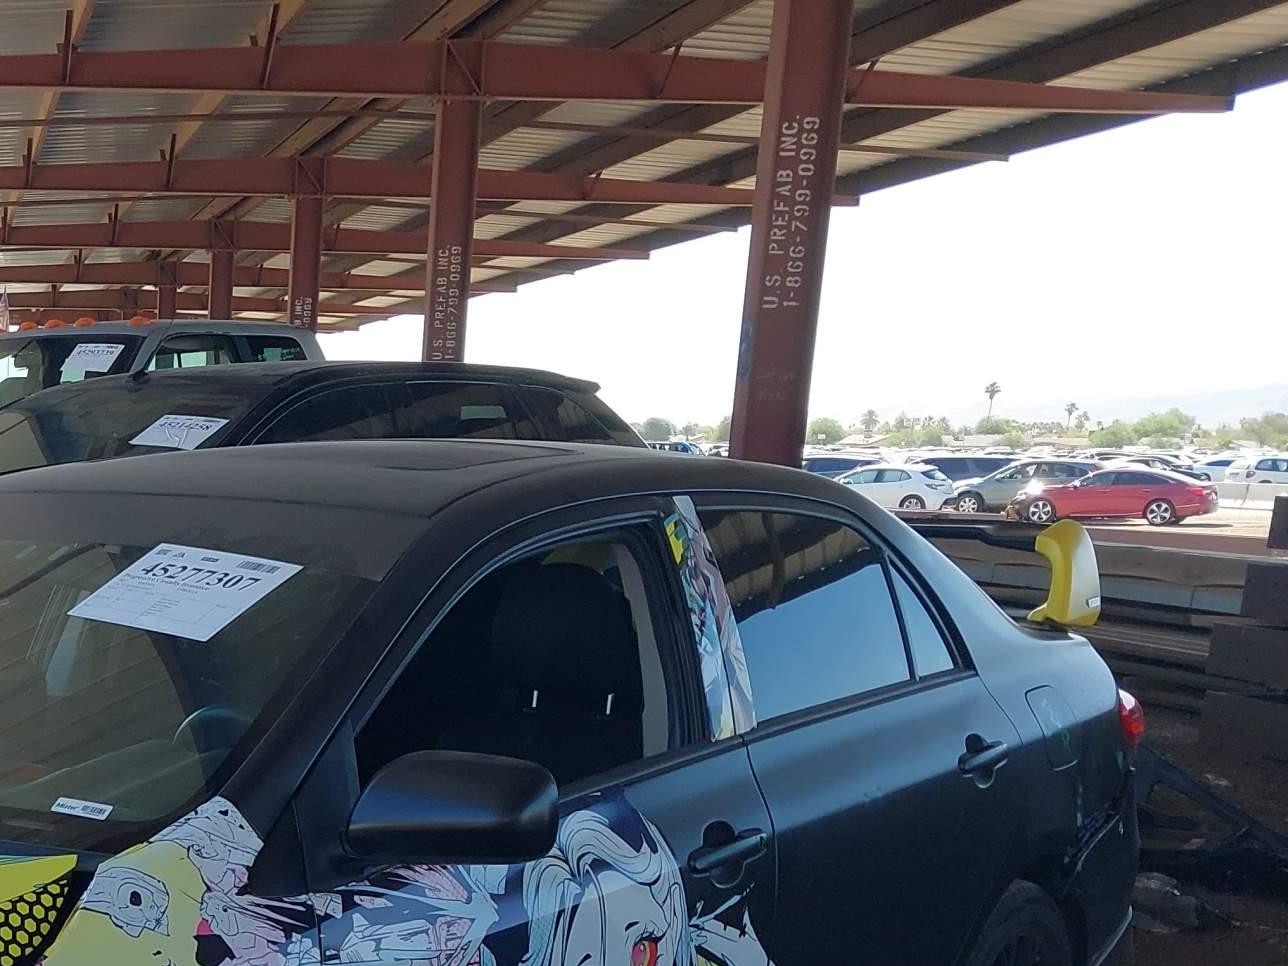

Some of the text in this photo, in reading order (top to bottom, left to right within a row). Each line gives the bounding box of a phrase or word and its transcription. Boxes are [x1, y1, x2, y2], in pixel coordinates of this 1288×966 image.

[763, 114, 800, 309] U.S. PREFAB INC.
[783, 116, 821, 306] 1-866-799-0969
[438, 244, 450, 270] INC.
[434, 277, 447, 328] PREFAB
[444, 246, 462, 359] 1-866-799-0969
[141, 561, 262, 592] 45277307
